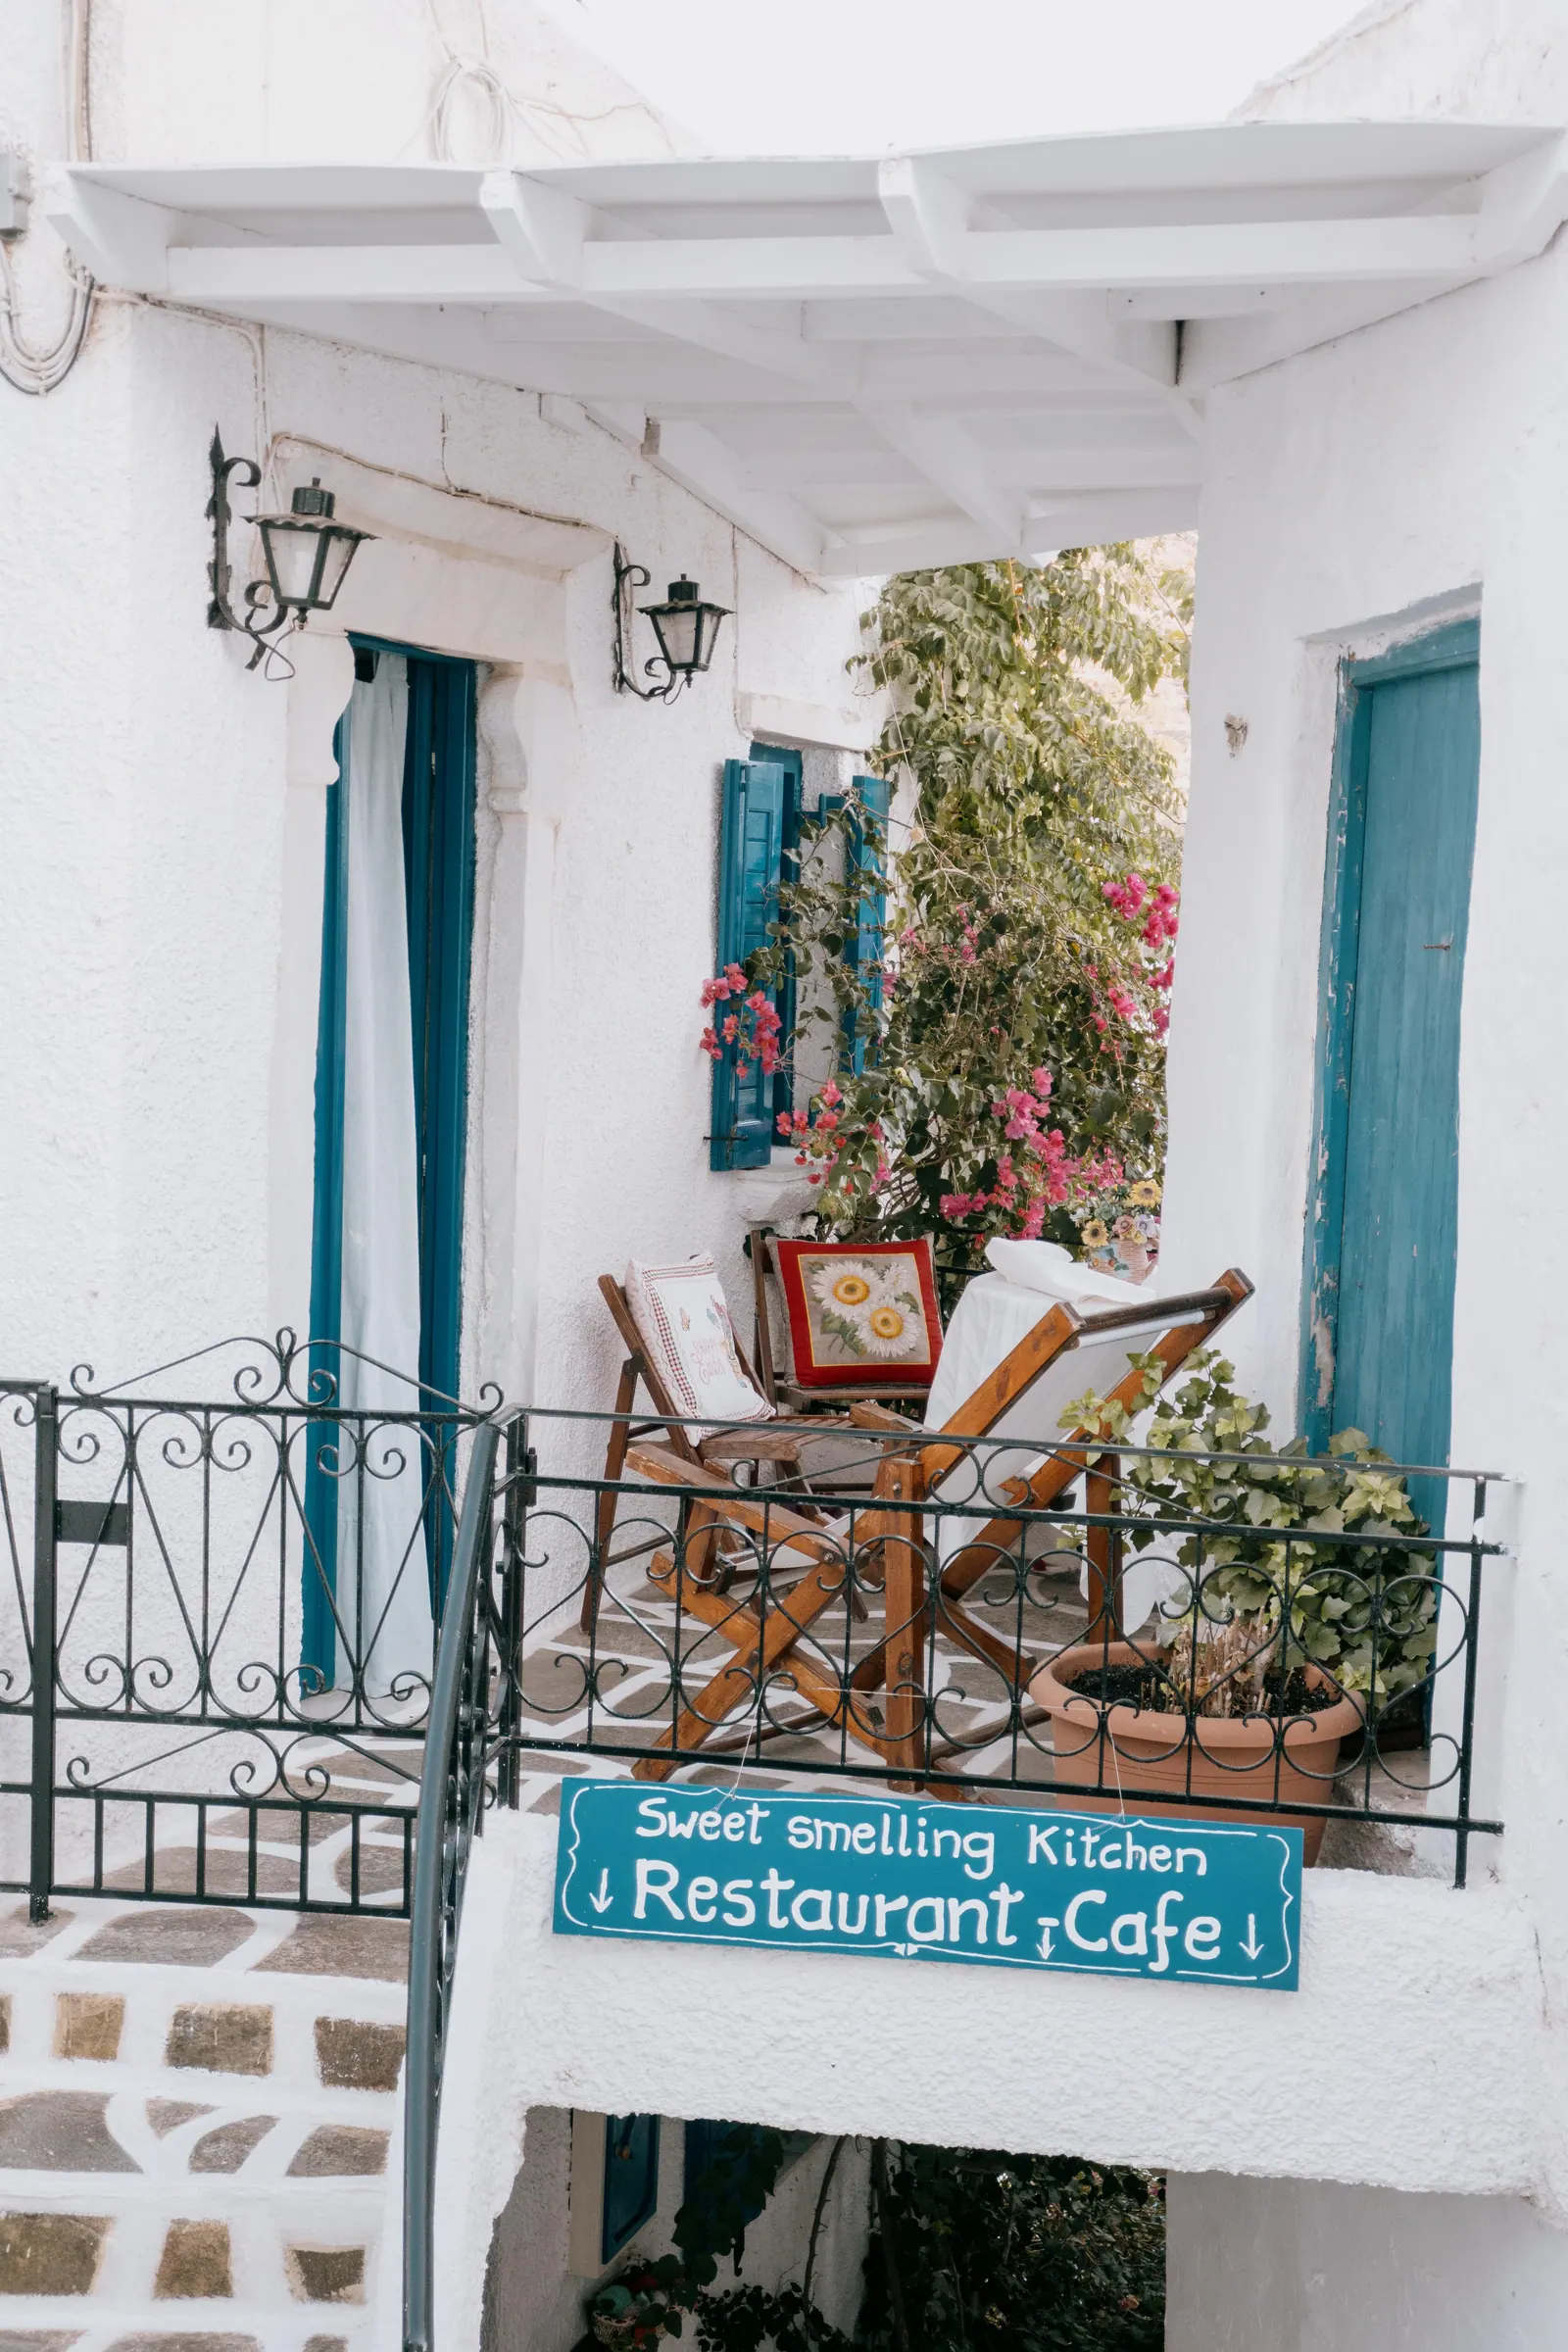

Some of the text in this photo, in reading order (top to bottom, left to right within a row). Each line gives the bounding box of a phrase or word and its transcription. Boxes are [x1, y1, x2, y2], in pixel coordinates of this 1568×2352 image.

[635, 1796, 1207, 1881] Sweet smelling Kitchen
[633, 1858, 1025, 1946] Restaurant
